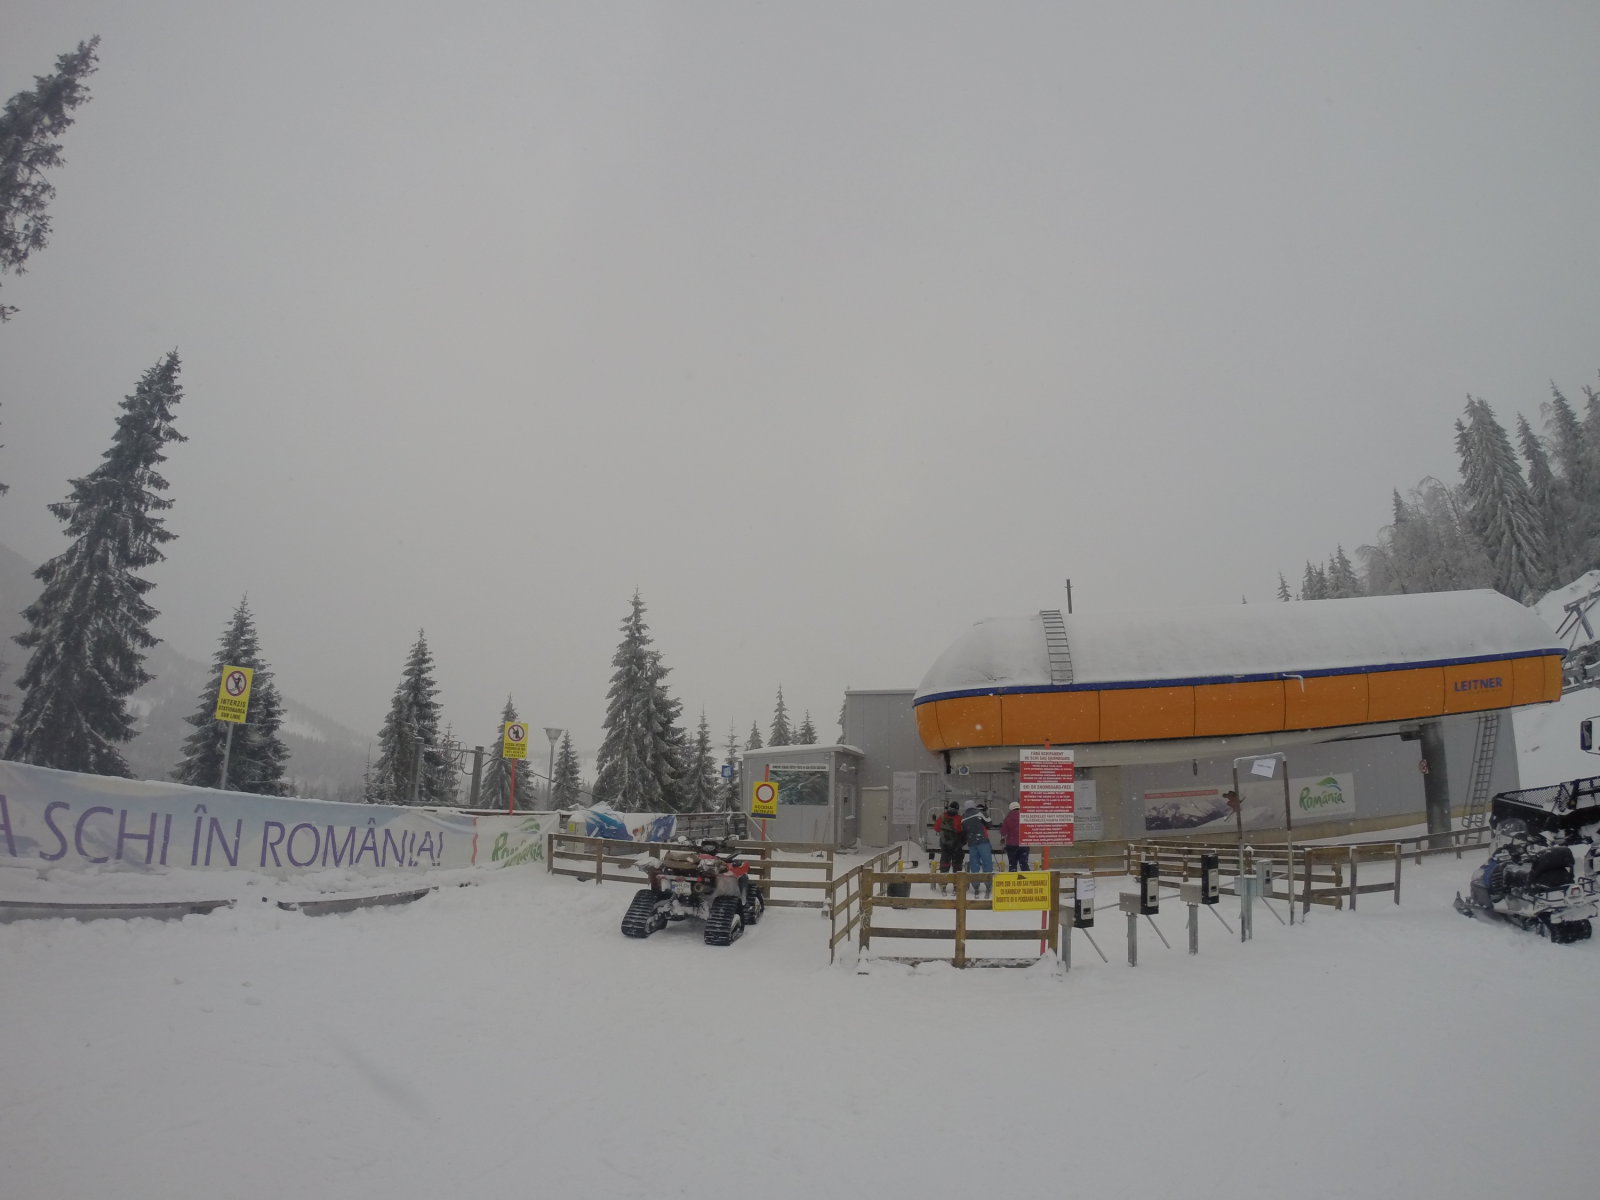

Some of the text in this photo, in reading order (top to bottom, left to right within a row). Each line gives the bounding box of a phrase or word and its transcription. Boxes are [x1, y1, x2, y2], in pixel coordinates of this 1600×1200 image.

[1454, 678, 1503, 692] LEITNER
[1299, 786, 1346, 811] România
[39, 801, 172, 865] SCHI
[190, 803, 242, 866] ÎN
[260, 817, 444, 867] ROMÂNIA!
